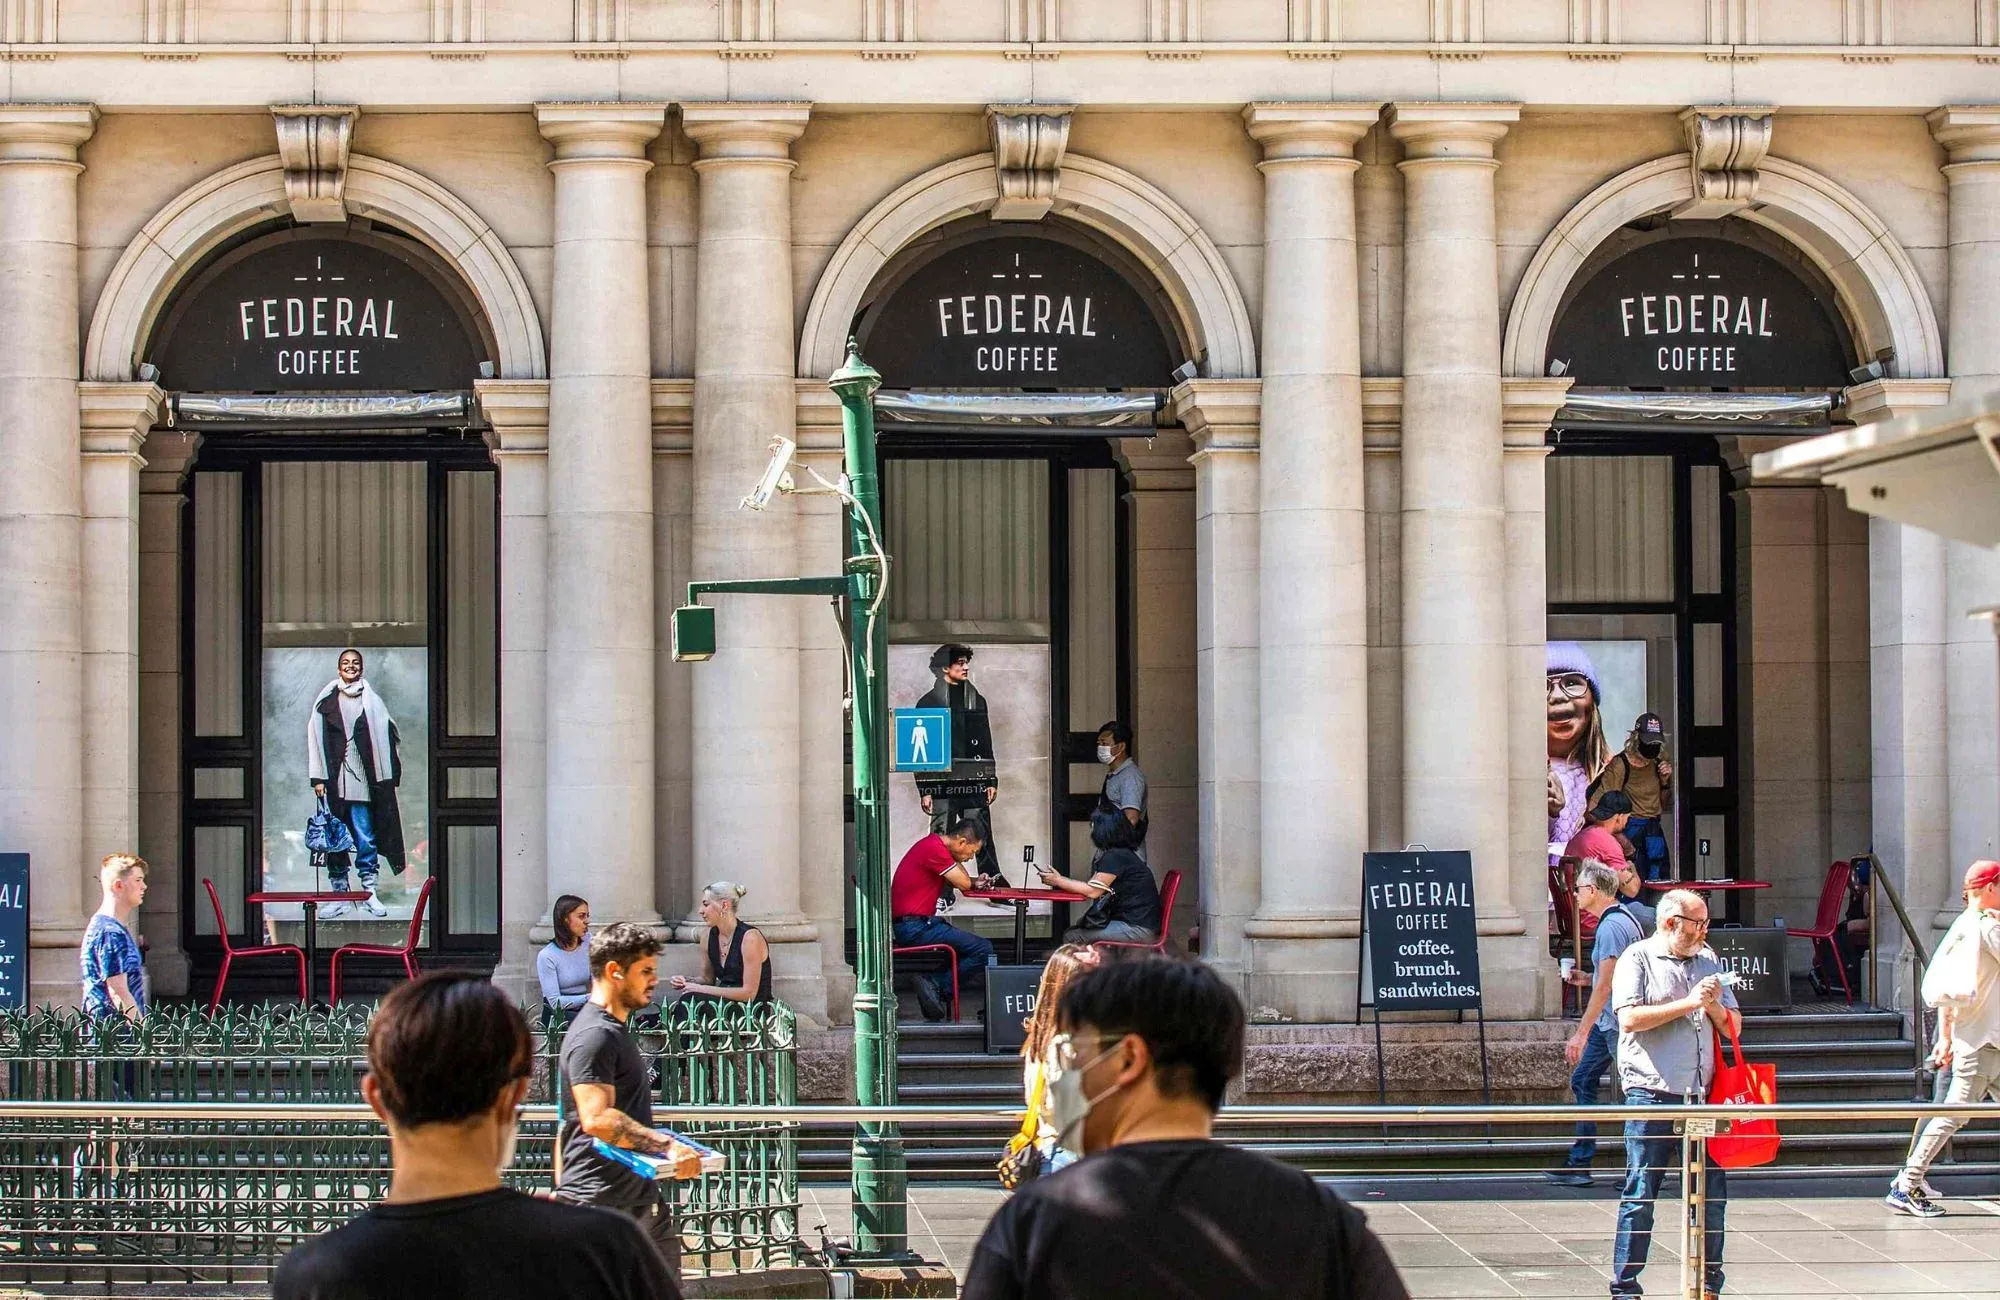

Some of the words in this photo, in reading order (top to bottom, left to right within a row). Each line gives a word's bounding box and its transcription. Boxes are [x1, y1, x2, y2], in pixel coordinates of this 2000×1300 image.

[239, 297, 399, 341] FEDERAL
[938, 294, 1096, 337] FEDERAL
[1620, 294, 1773, 337] FEDERAL
[278, 350, 360, 375] COFFEE
[977, 347, 1058, 371] COFFEE
[1657, 347, 1736, 371] COFFEE
[1702, 841, 1708, 853] 8
[312, 852, 325, 865] 14
[1370, 881, 1471, 910] FEDERAL
[1396, 913, 1448, 930] COFFEE
[1398, 939, 1454, 956] coffee.
[1394, 960, 1461, 977] brunch.
[1720, 956, 1770, 976] DERAL
[1378, 981, 1480, 999] sandwiches.
